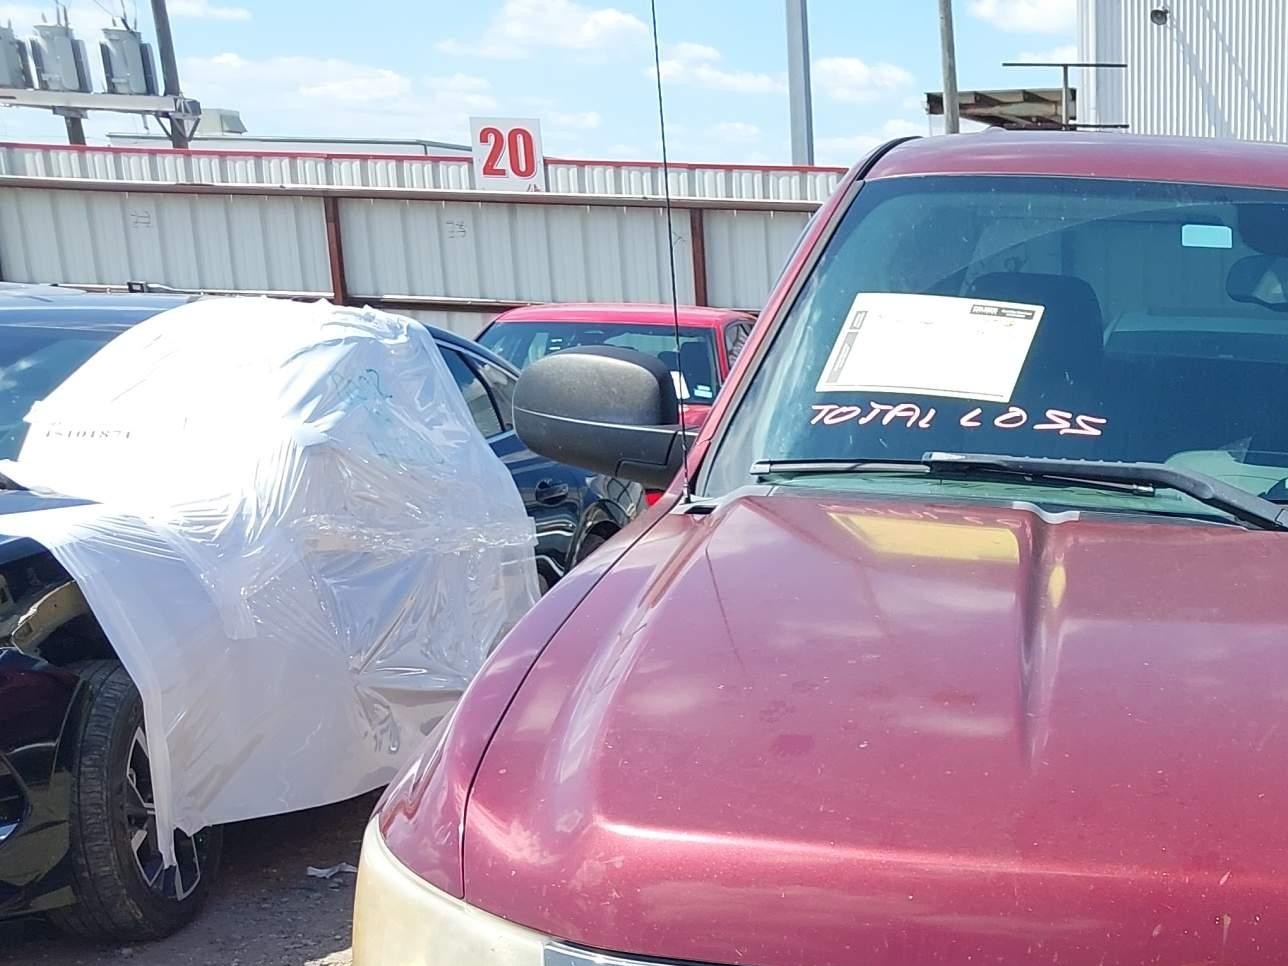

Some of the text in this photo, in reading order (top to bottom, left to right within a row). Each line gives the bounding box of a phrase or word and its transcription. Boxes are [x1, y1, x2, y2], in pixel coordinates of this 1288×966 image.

[479, 126, 537, 179] 20
[810, 400, 1108, 436] TOTAL LOSS
